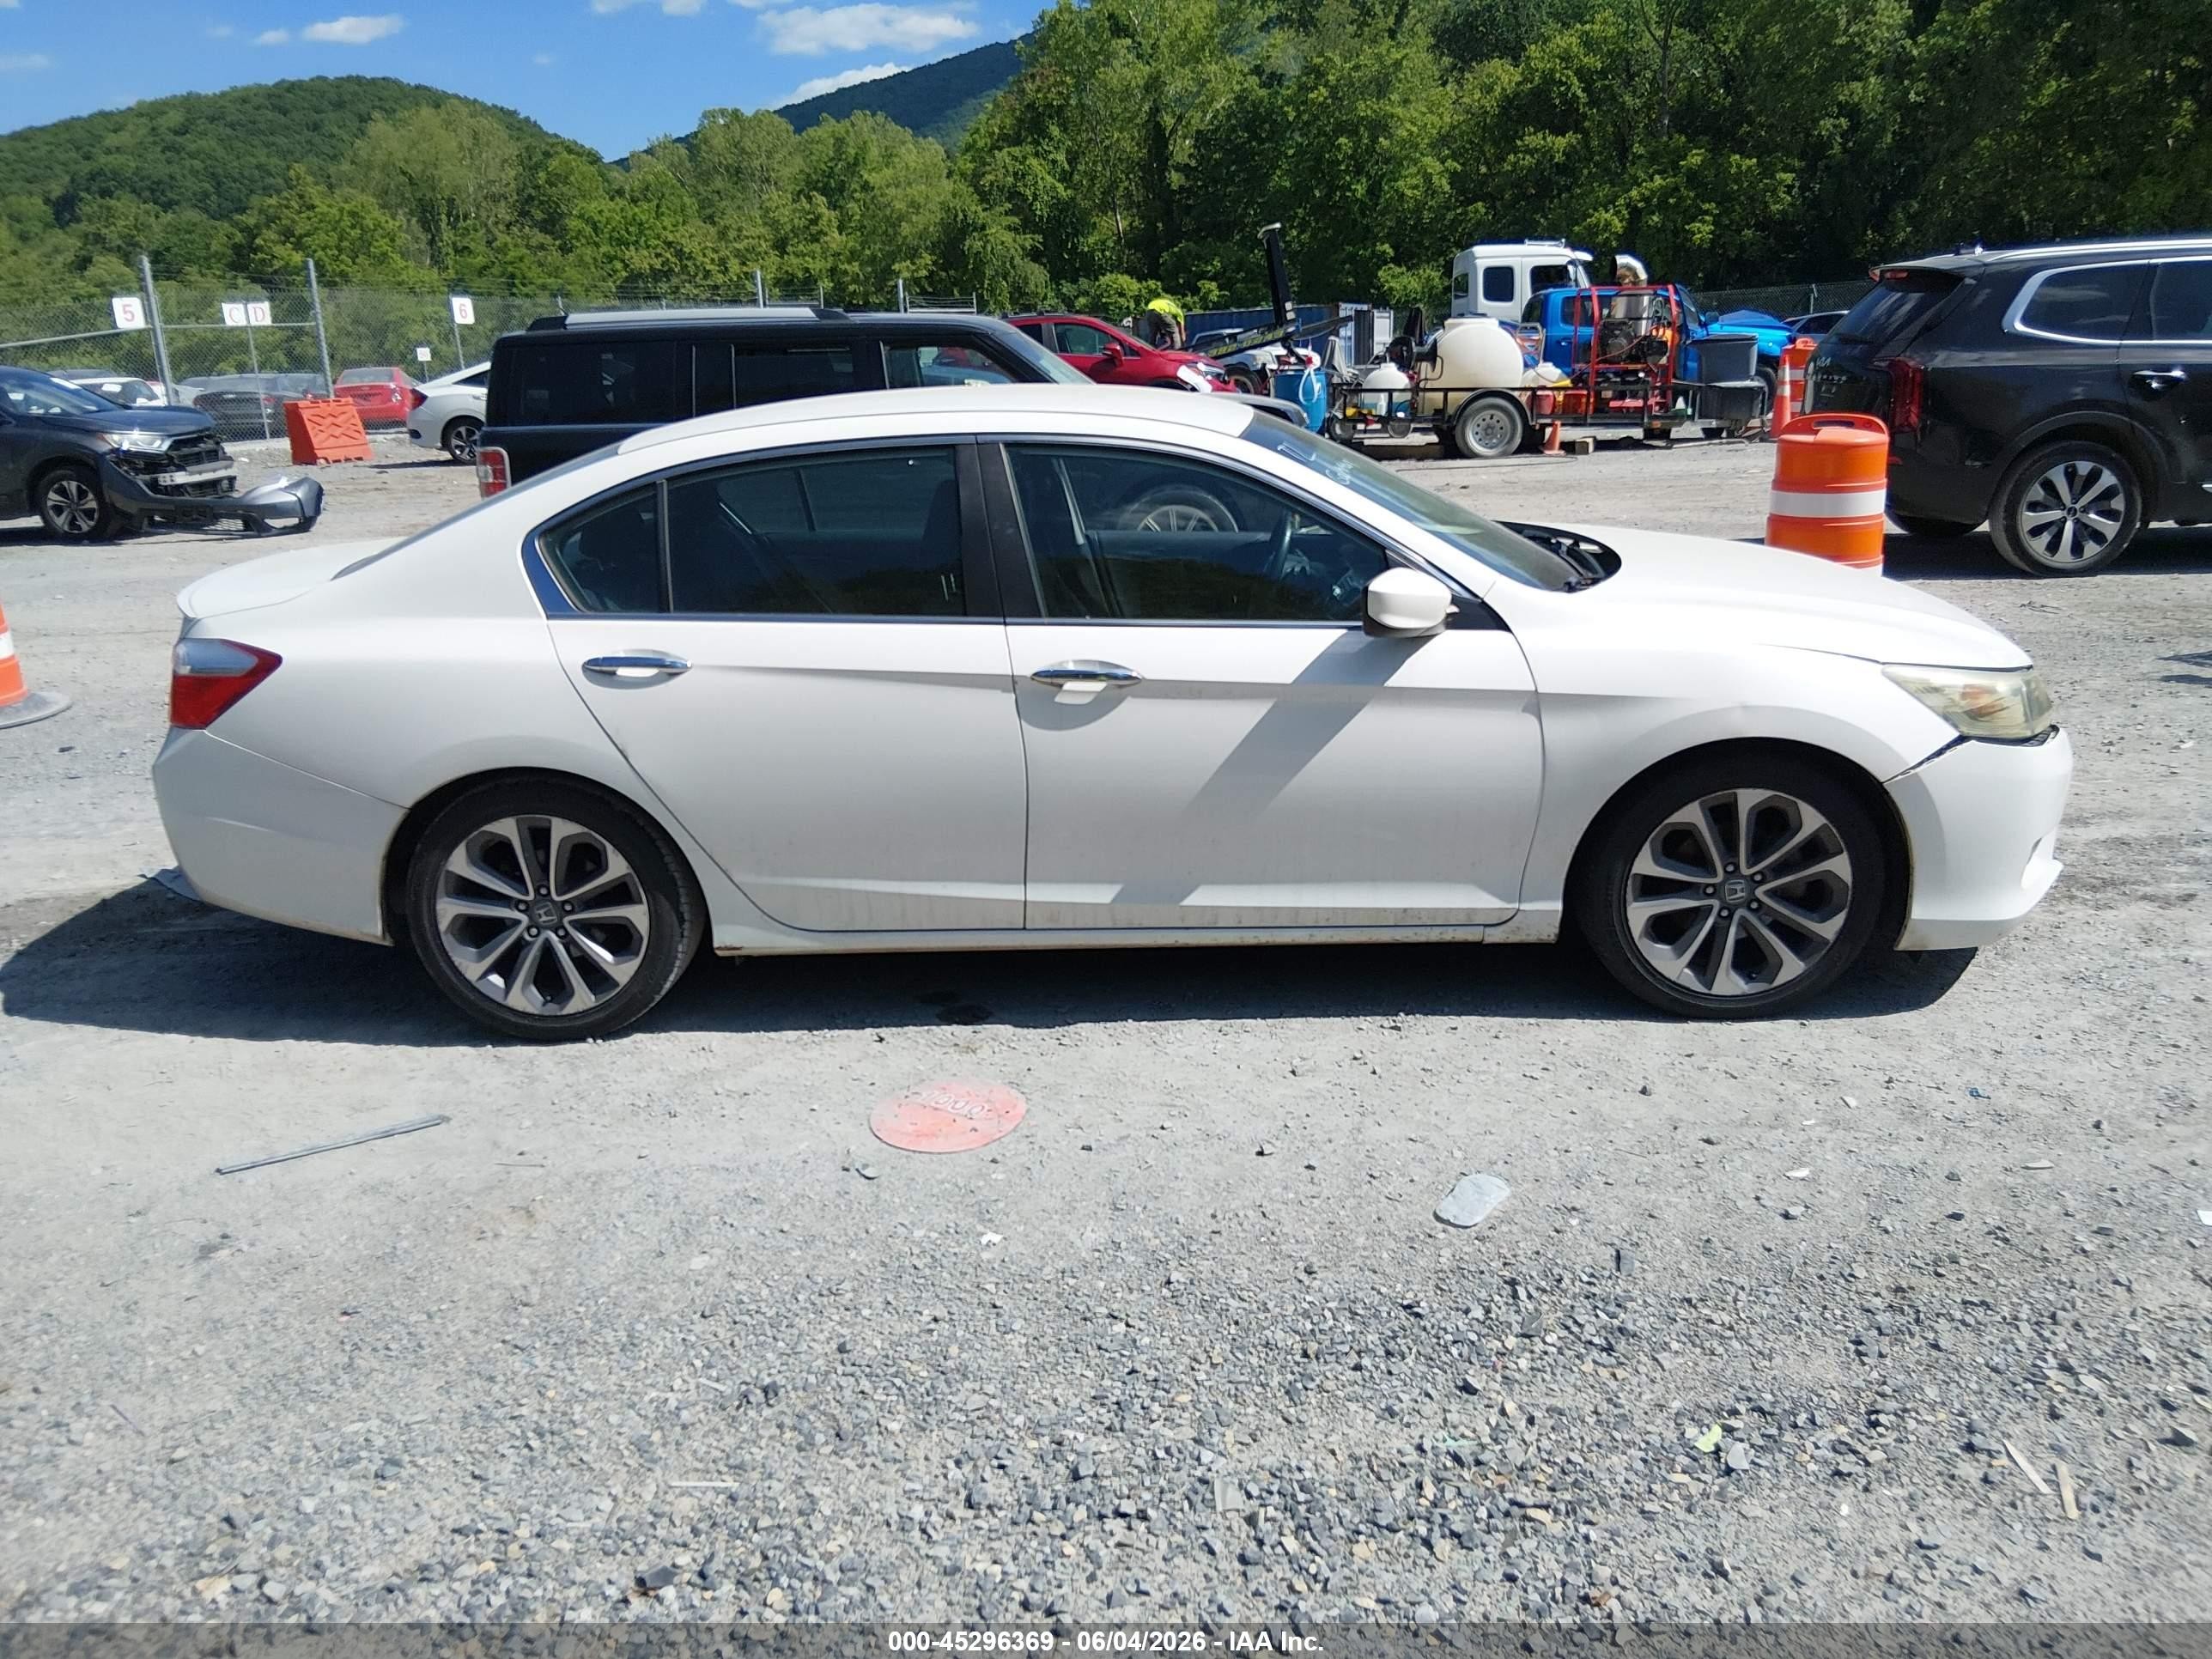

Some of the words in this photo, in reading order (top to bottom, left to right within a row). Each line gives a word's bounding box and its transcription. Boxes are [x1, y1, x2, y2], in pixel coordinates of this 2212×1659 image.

[121, 303, 136, 323] 5
[228, 307, 242, 324] C
[252, 306, 266, 323] D
[459, 303, 468, 319] 6
